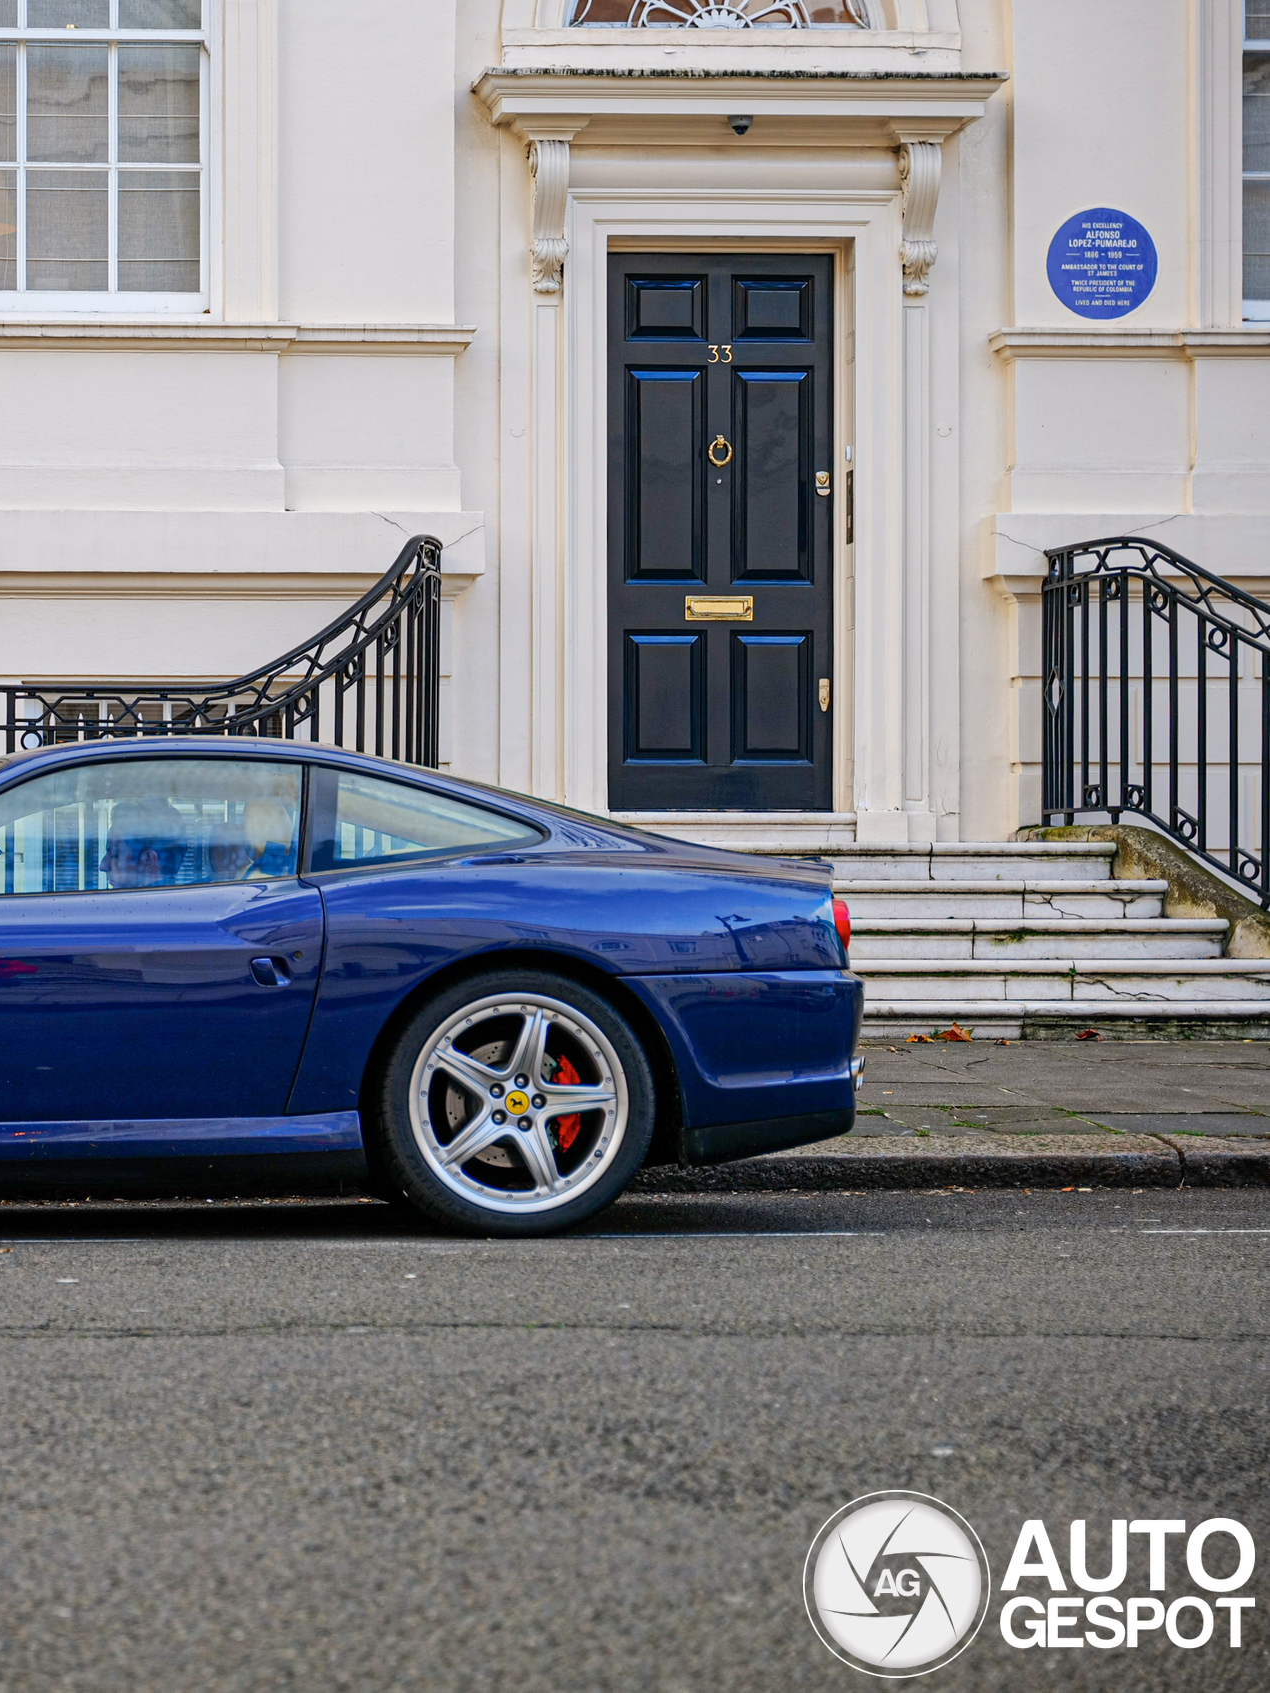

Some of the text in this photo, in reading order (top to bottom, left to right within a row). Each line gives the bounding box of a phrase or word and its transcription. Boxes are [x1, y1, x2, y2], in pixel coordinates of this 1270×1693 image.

[1086, 231, 1120, 239] ALFONSO
[1069, 239, 1137, 248] LOPEZ-PUMAREJO
[707, 345, 733, 363] 33
